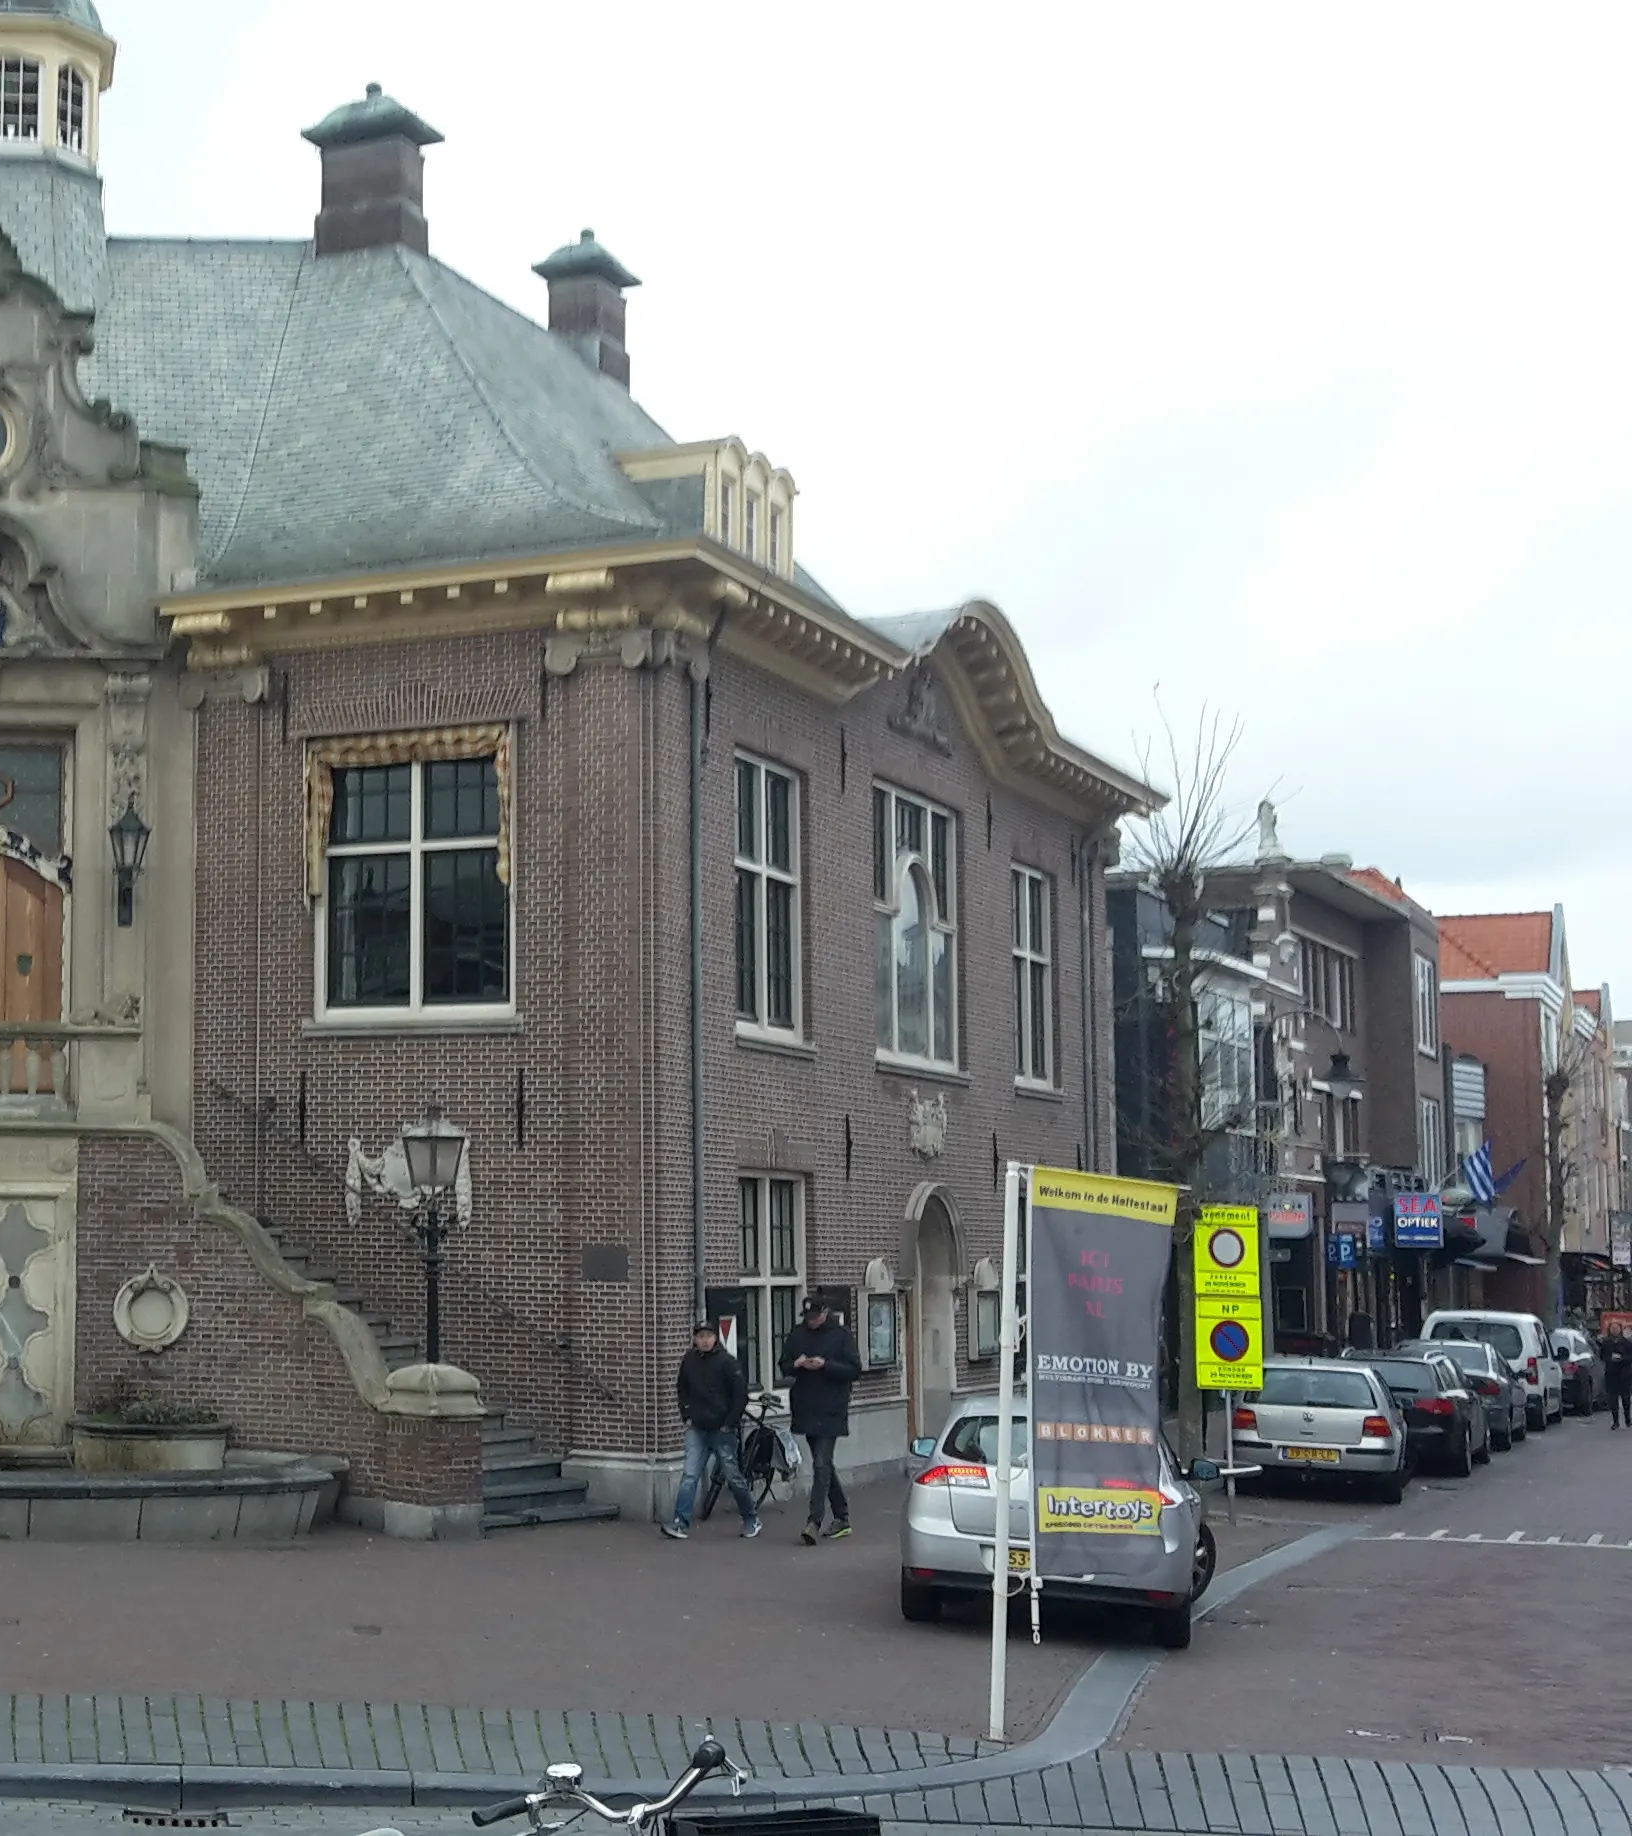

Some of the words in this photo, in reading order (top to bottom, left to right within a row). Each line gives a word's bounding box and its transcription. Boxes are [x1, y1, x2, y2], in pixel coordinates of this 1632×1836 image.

[1039, 1185, 1082, 1201] Welkom
[1096, 1193, 1110, 1204] de
[1200, 1209, 1251, 1221] venement
[1398, 1196, 1439, 1215] SEA
[1397, 1217, 1438, 1229] OPTIEK
[1037, 1354, 1119, 1375] EMOTION
[1125, 1361, 1153, 1379] BY
[1047, 1494, 1153, 1522] Intertoys
